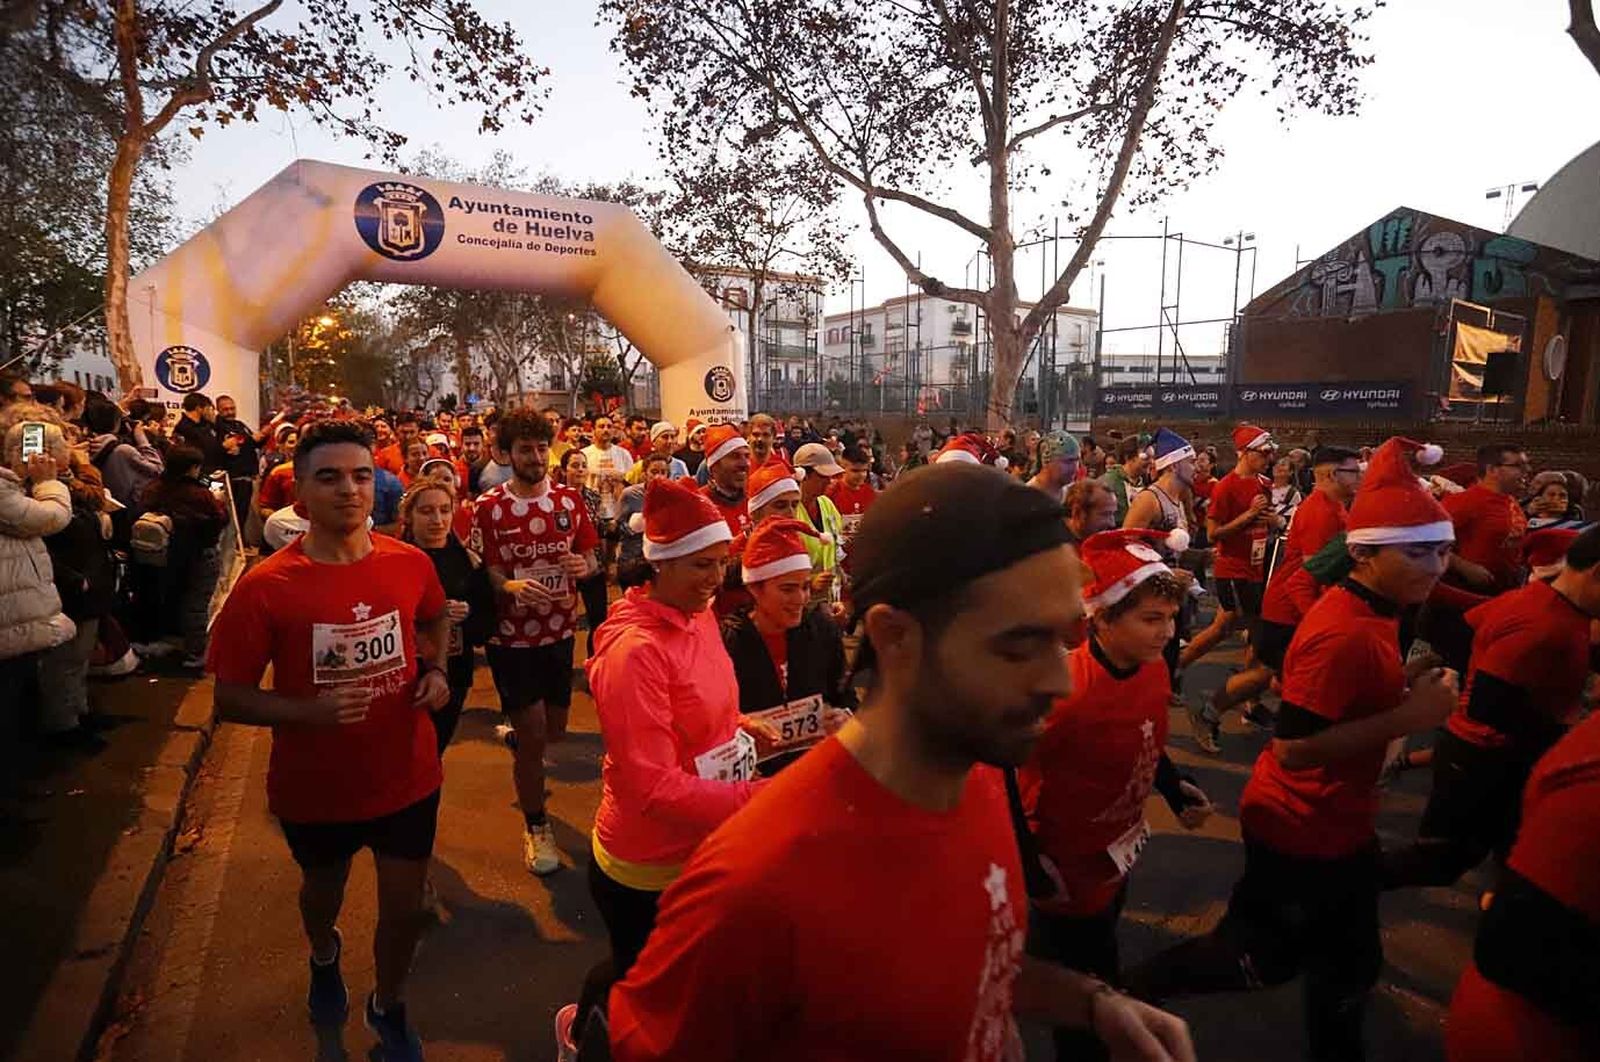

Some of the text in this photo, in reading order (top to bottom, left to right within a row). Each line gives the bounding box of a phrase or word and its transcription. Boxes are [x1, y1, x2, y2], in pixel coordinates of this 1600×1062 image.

[448, 196, 594, 225] Ayuntamiento
[492, 218, 595, 242] de Huelva
[526, 240, 541, 252] de
[544, 242, 597, 257] Deportes
[1177, 392, 1219, 401] HYUNDAI
[1258, 389, 1308, 400] HYUNDAI
[1342, 388, 1401, 400] HYUNDAI
[354, 632, 395, 663] 300
[781, 714, 819, 741] 573
